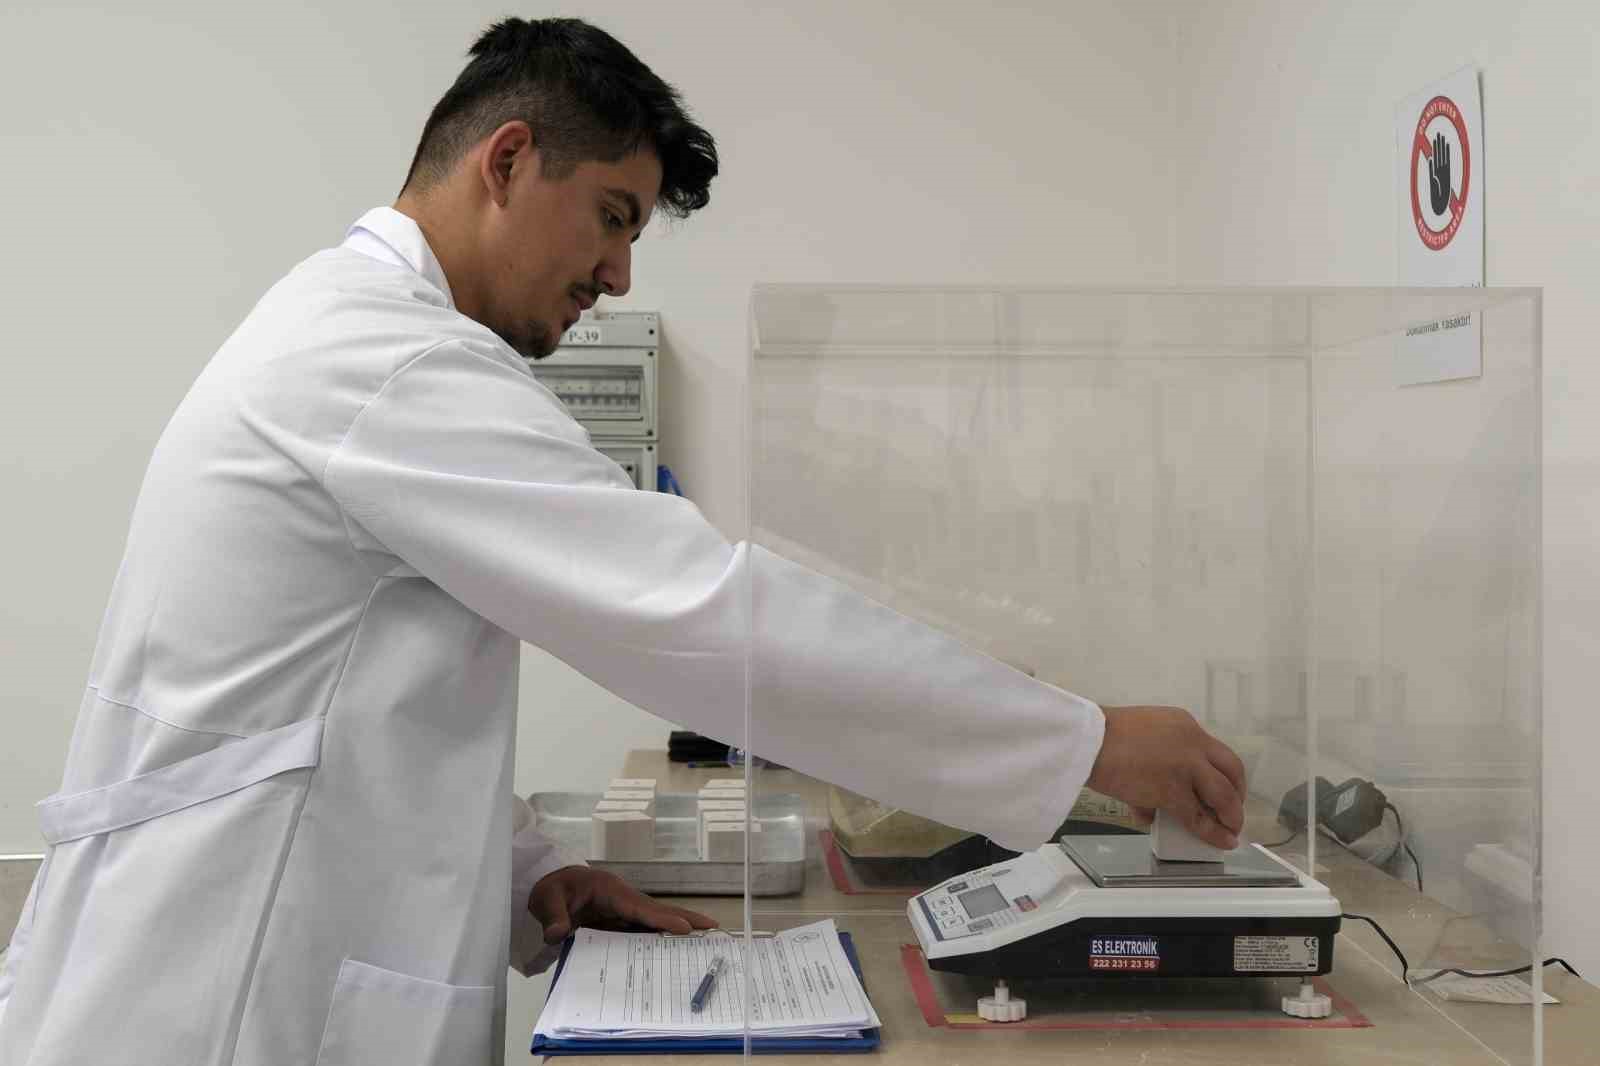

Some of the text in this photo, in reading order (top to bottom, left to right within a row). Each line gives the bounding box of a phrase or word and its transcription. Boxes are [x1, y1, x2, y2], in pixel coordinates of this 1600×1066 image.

[568, 330, 599, 343] P-39
[1092, 938, 1157, 955] ES ELEKTRONİK
[1094, 959, 1110, 968] 222
[1112, 959, 1128, 968] 231
[1130, 959, 1142, 968] 23
